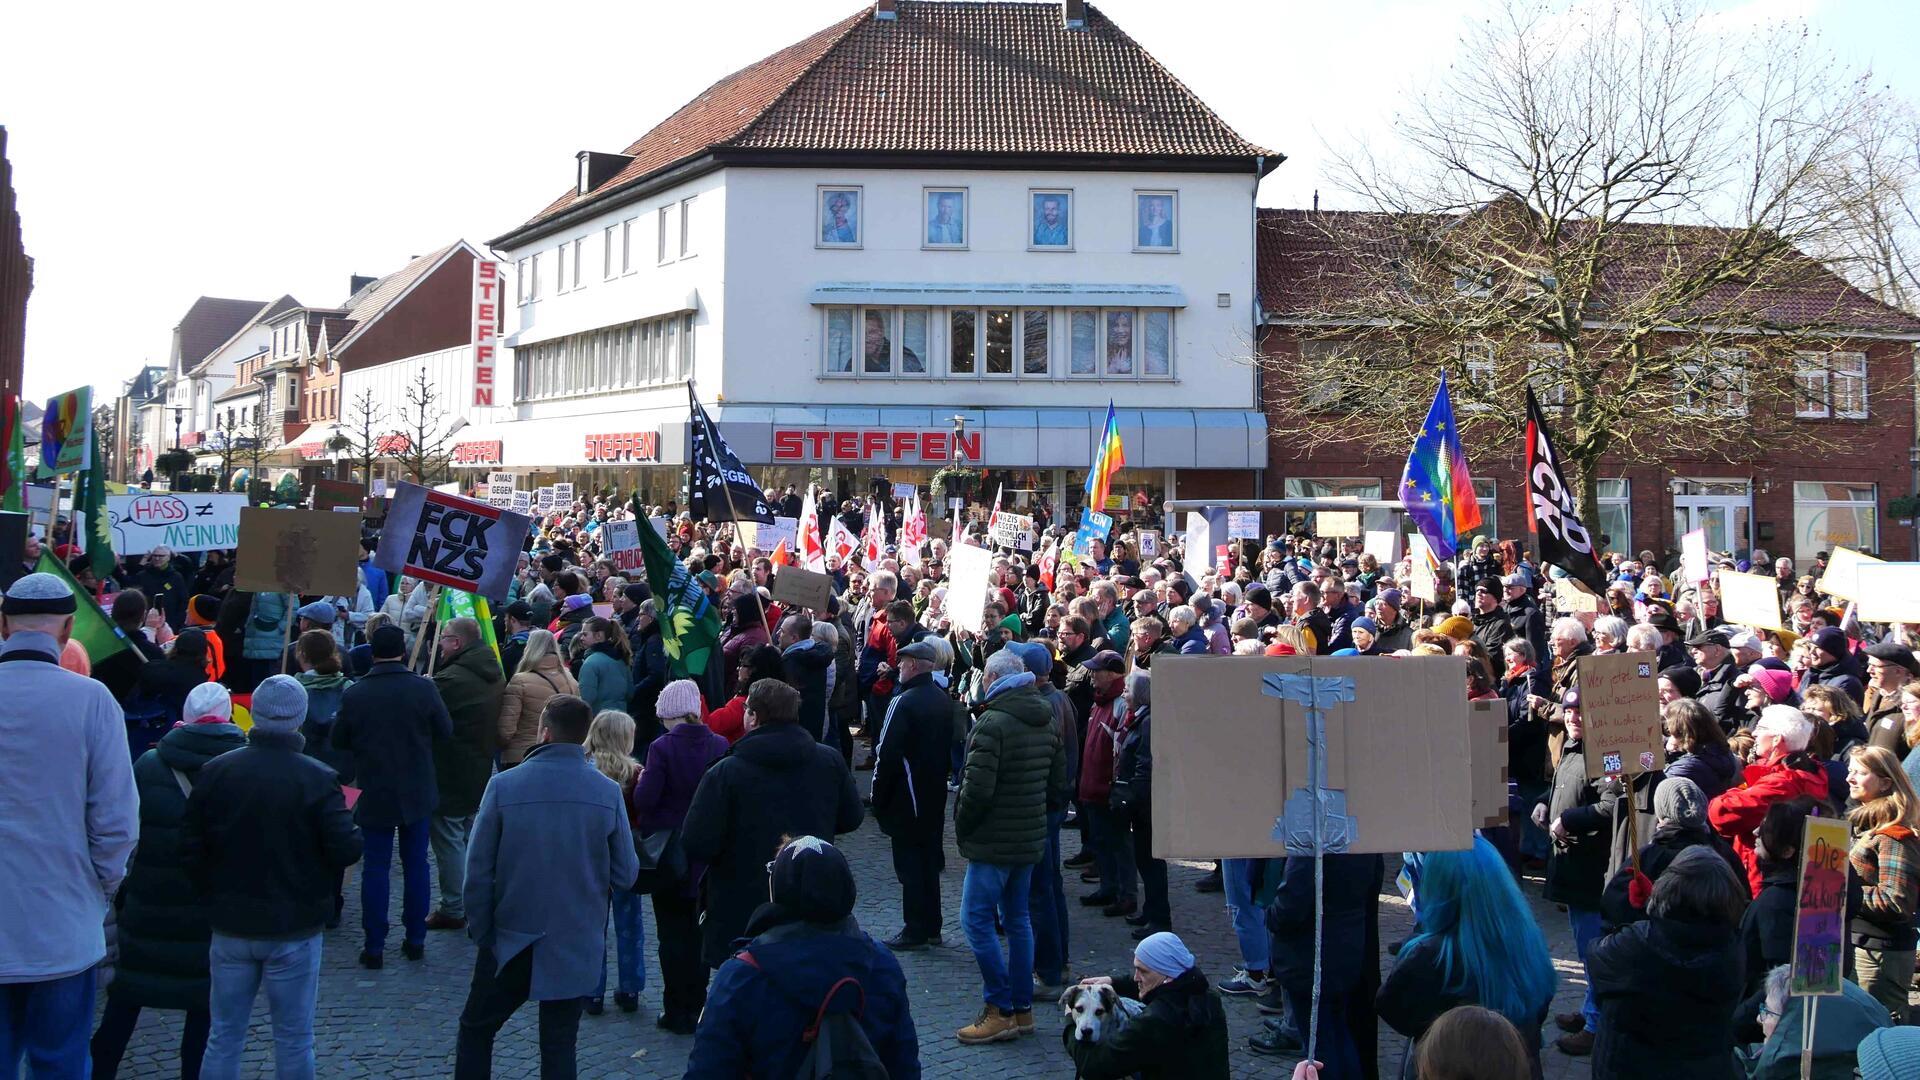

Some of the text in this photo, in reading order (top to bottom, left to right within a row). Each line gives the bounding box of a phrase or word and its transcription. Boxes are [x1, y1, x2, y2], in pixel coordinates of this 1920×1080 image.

[475, 261, 497, 406] STEFFEN
[454, 440, 502, 462] STEFFEN
[585, 431, 656, 460] STEFFEN
[775, 430, 981, 461] STEFFEN
[494, 474, 512, 482] OMAS
[492, 486, 513, 494] GEGEN
[135, 500, 184, 520] HASS
[998, 514, 1018, 524] NAZIS
[1088, 512, 1112, 528] KEIN
[164, 524, 240, 548] MEINUN
[416, 502, 496, 551] FCK
[998, 522, 1018, 532] ESSEN
[998, 529, 1026, 541] HEIMLICH
[407, 533, 488, 581] NZS
[1603, 754, 1620, 765] FCK
[1604, 762, 1622, 772] AFD
[1814, 836, 1840, 870] Die
